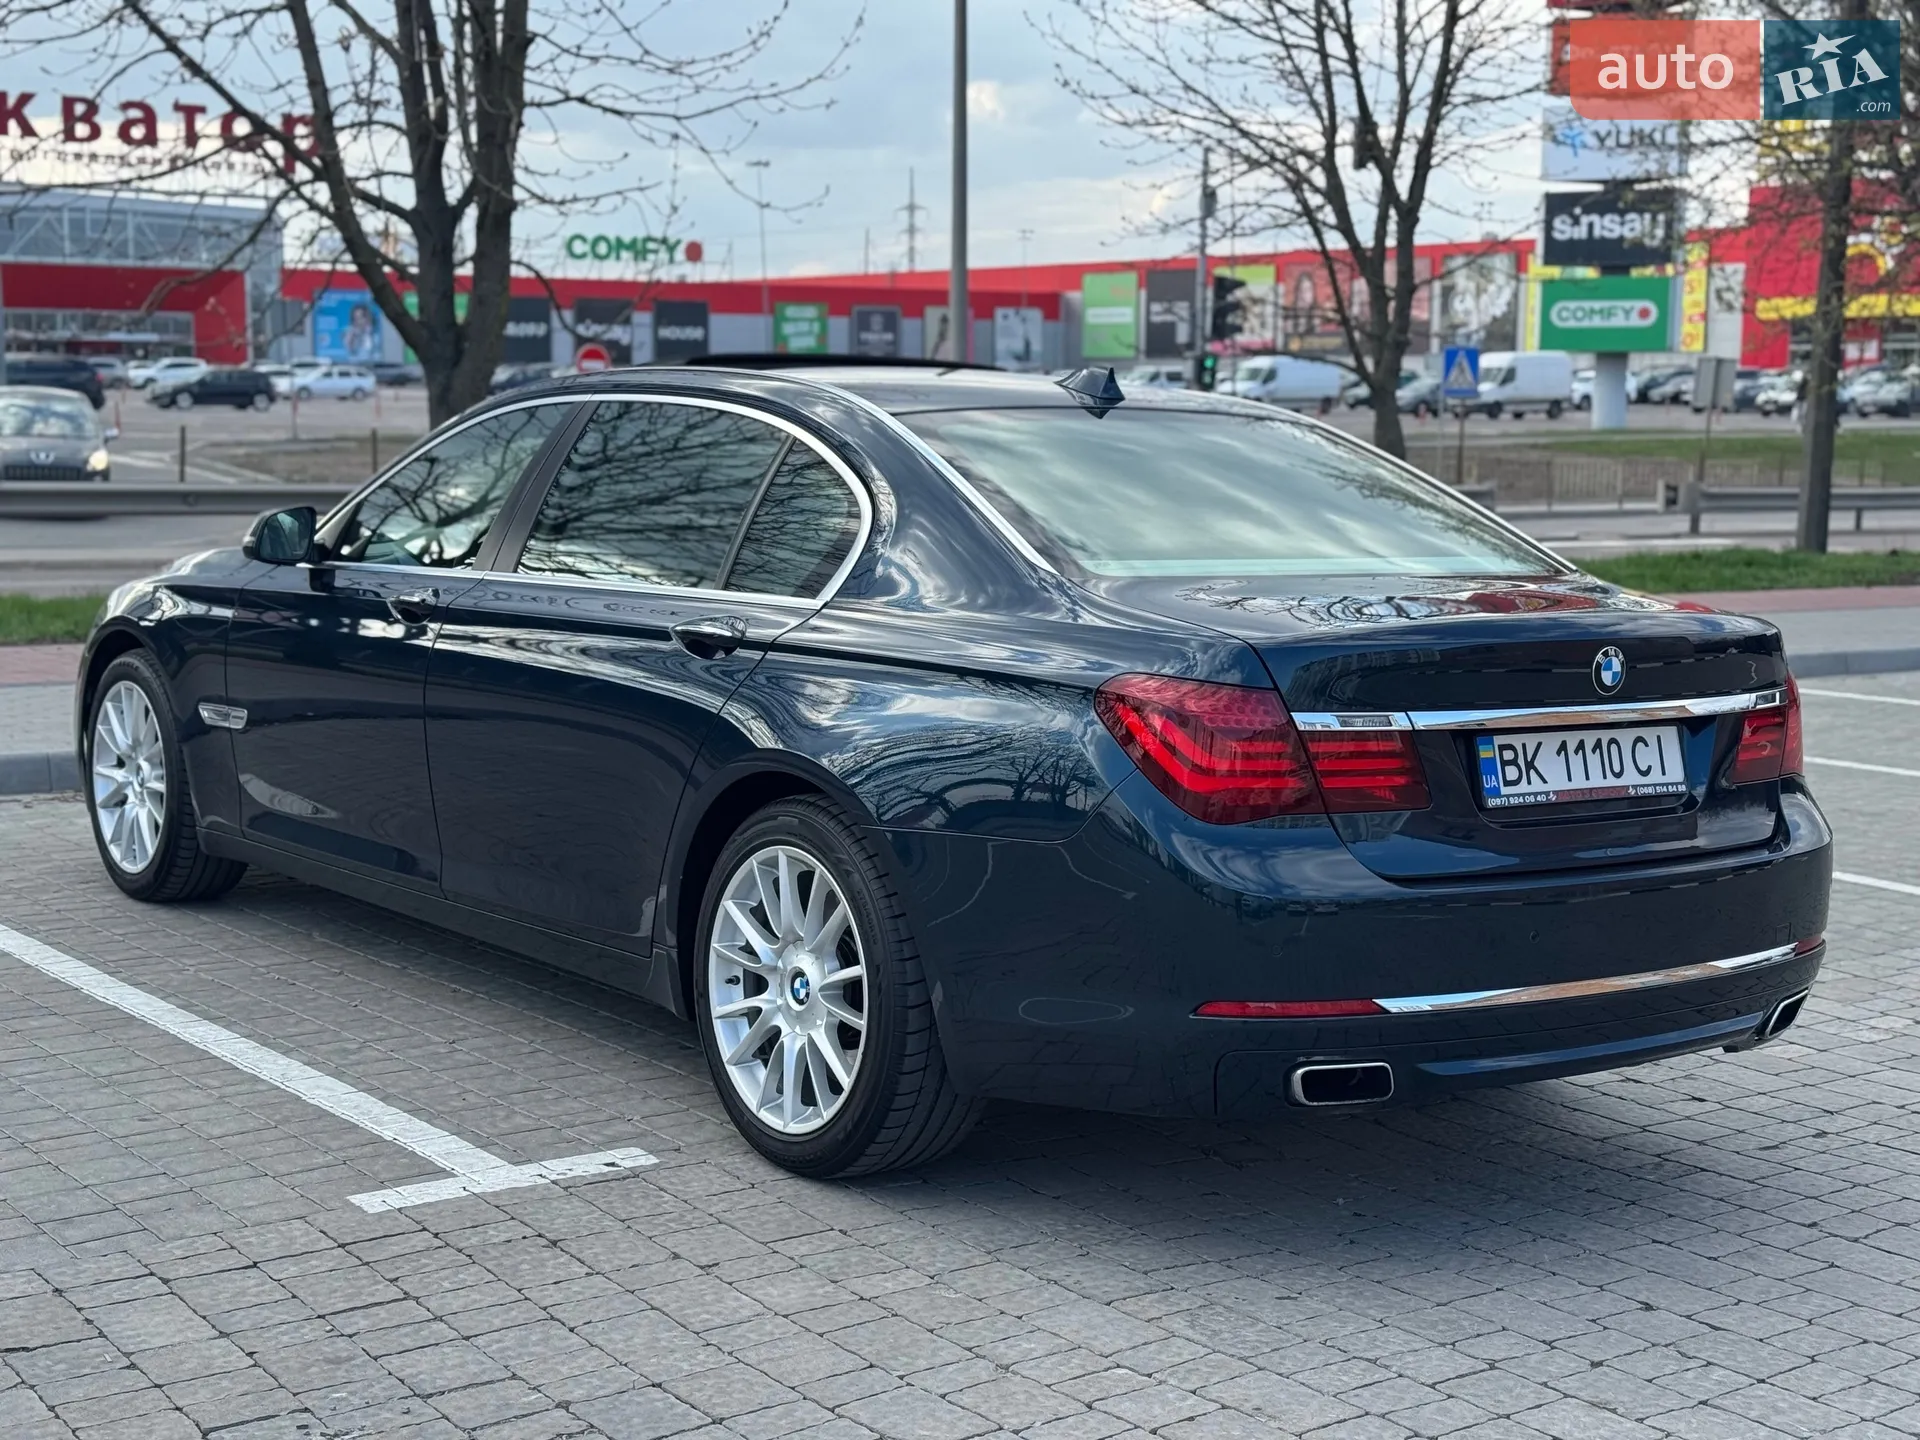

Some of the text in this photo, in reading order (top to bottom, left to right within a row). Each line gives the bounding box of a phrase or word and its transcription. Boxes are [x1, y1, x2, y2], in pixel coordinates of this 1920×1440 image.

[1552, 206, 1666, 248] sinsay
[567, 234, 682, 264] COMFY
[1557, 304, 1635, 322] COMFY
[1498, 735, 1666, 787] BK 1110 CI
[1483, 774, 1498, 788] UA
[1656, 785, 1667, 794] 514
[1488, 797, 1508, 807] (097)
[1509, 795, 1524, 804] 924
[1537, 793, 1547, 802] 40
